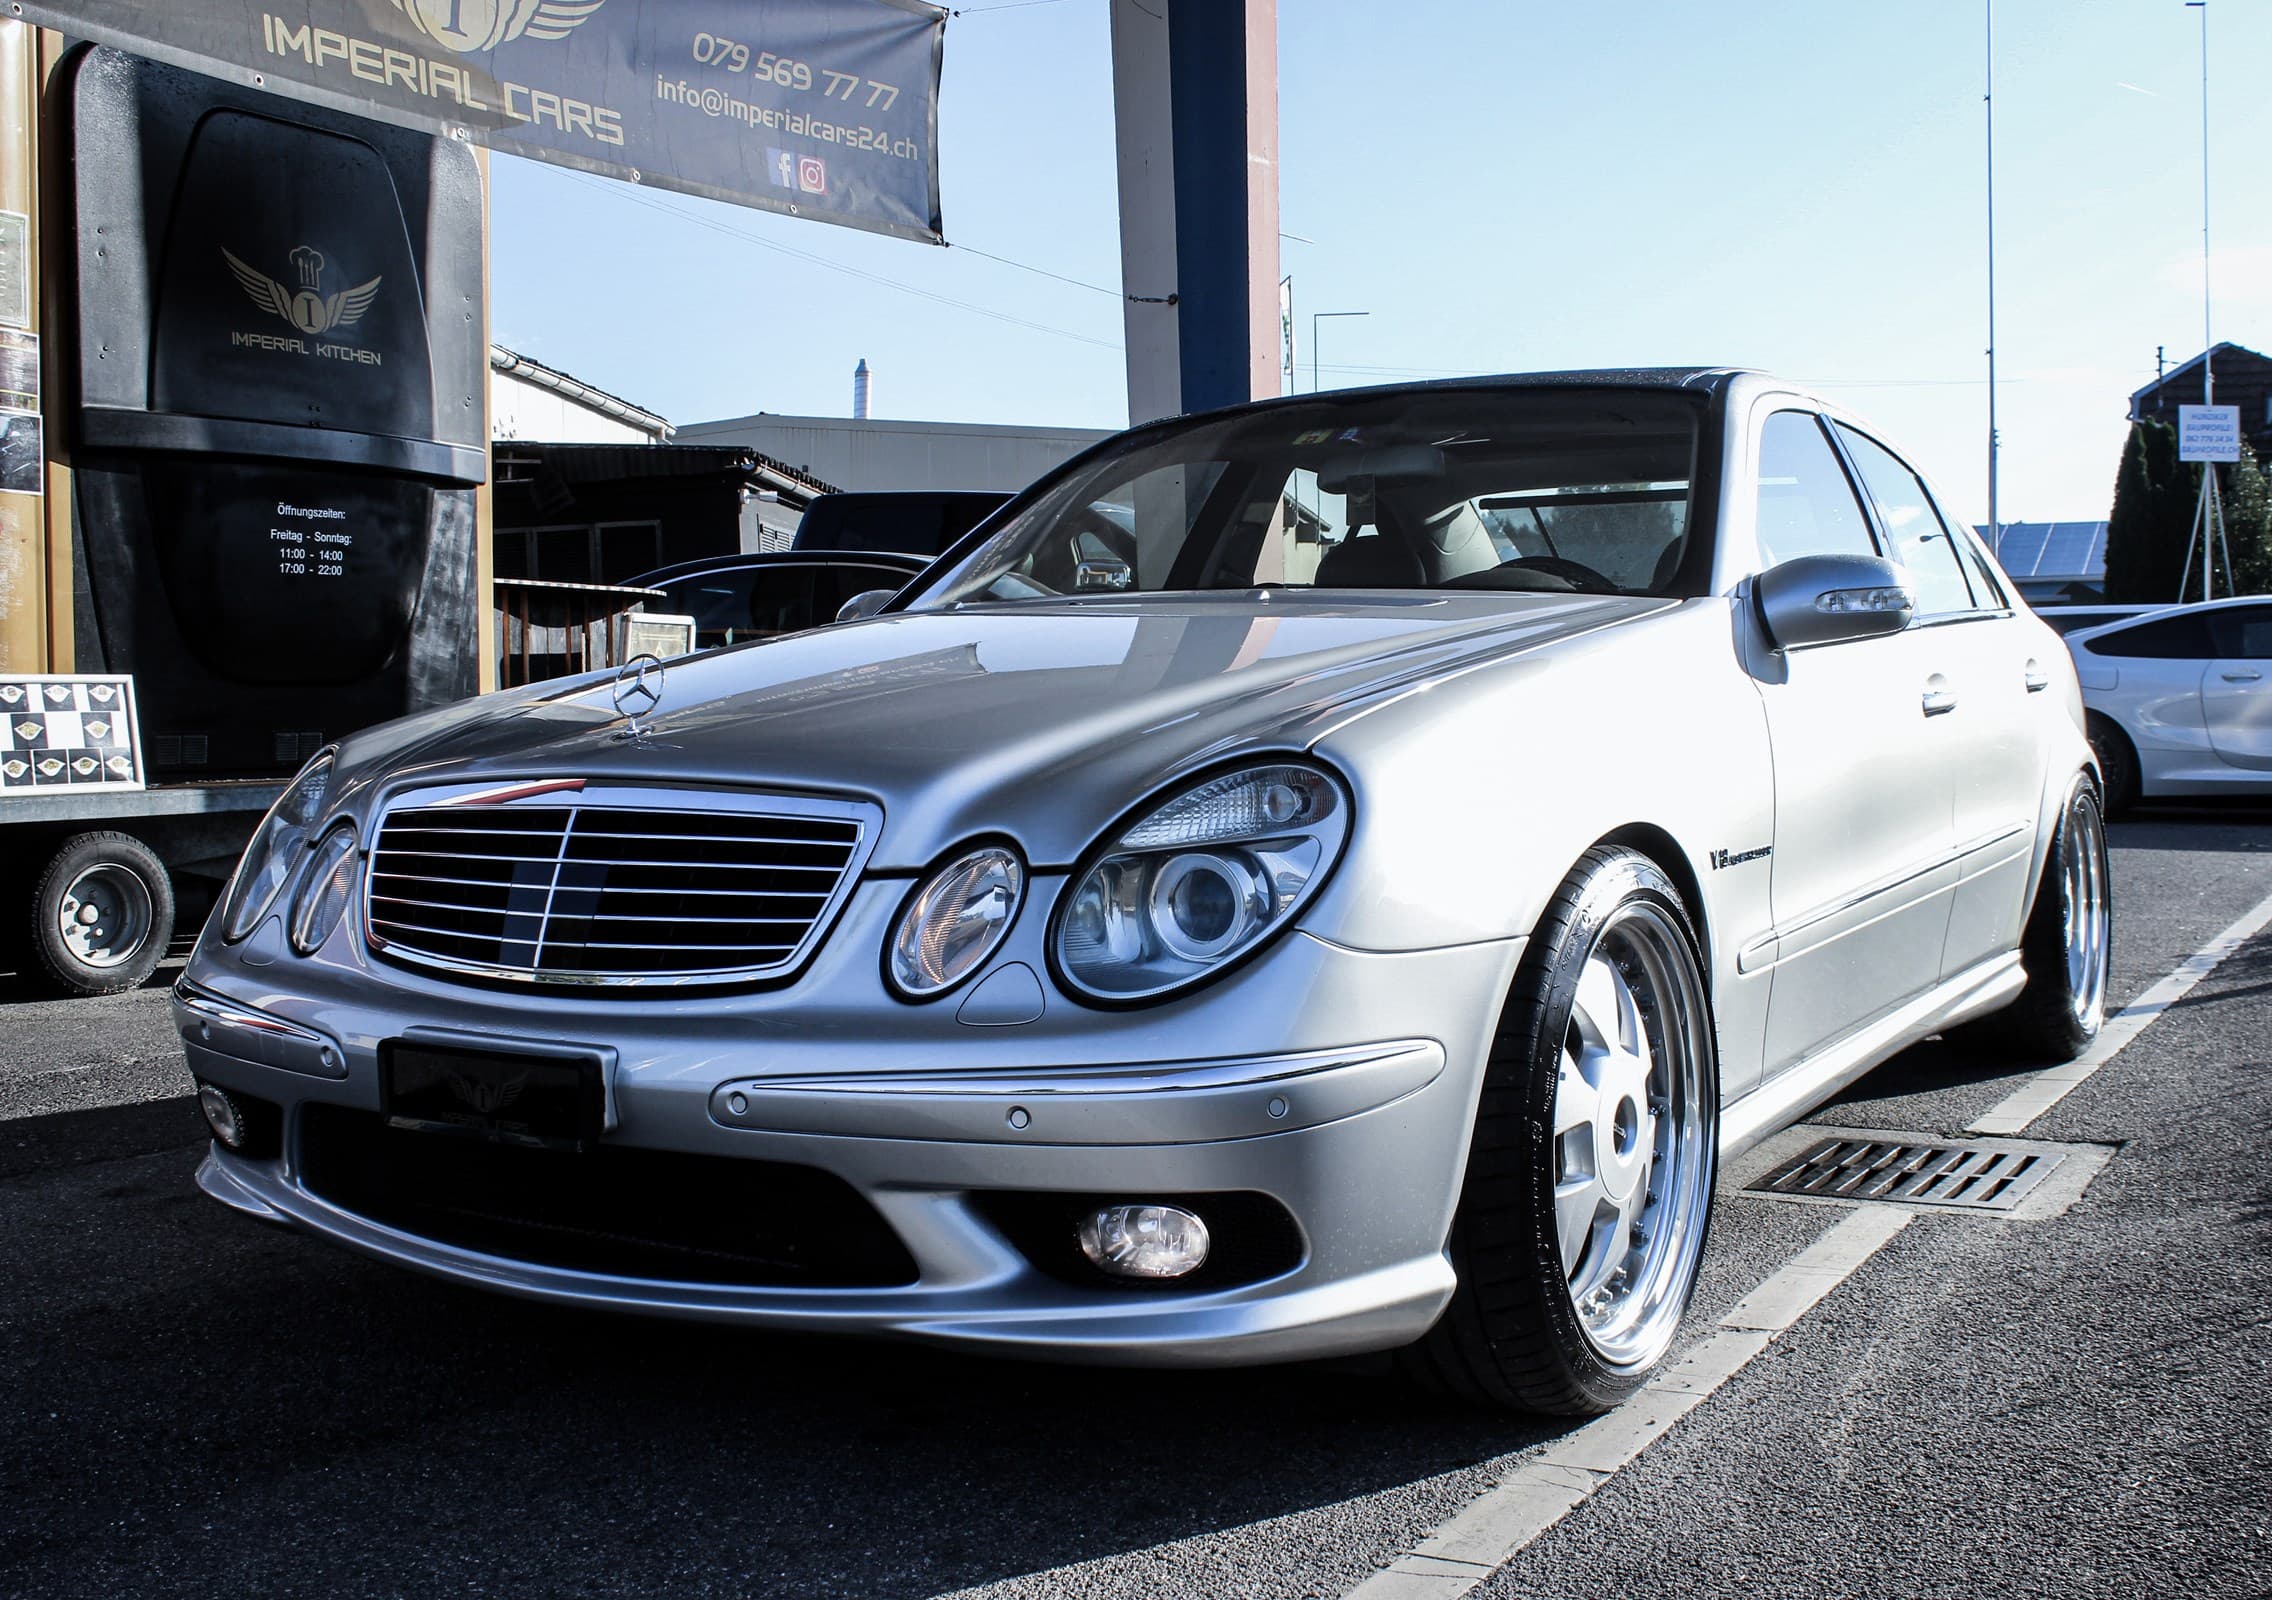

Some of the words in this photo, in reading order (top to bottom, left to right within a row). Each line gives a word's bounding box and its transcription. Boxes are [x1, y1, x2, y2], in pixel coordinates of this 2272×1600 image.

[263, 13, 488, 111] IMPERIAL
[503, 82, 625, 146] CARS
[692, 32, 750, 73] 079
[754, 51, 813, 91] 569
[822, 69, 859, 101] 77
[865, 80, 900, 112] 77
[657, 74, 918, 161] info@imperialcars24.ch
[231, 331, 309, 355] IMPERIAL
[316, 343, 382, 367] KITCHEN
[277, 502, 346, 519] Öffnungszeiten:
[270, 528, 303, 543] Freitag
[314, 531, 352, 546] Sonntag:
[280, 548, 305, 559] 11:00
[319, 550, 343, 561] 14:00
[280, 563, 305, 574] 17:00
[318, 565, 343, 576] 22:00
